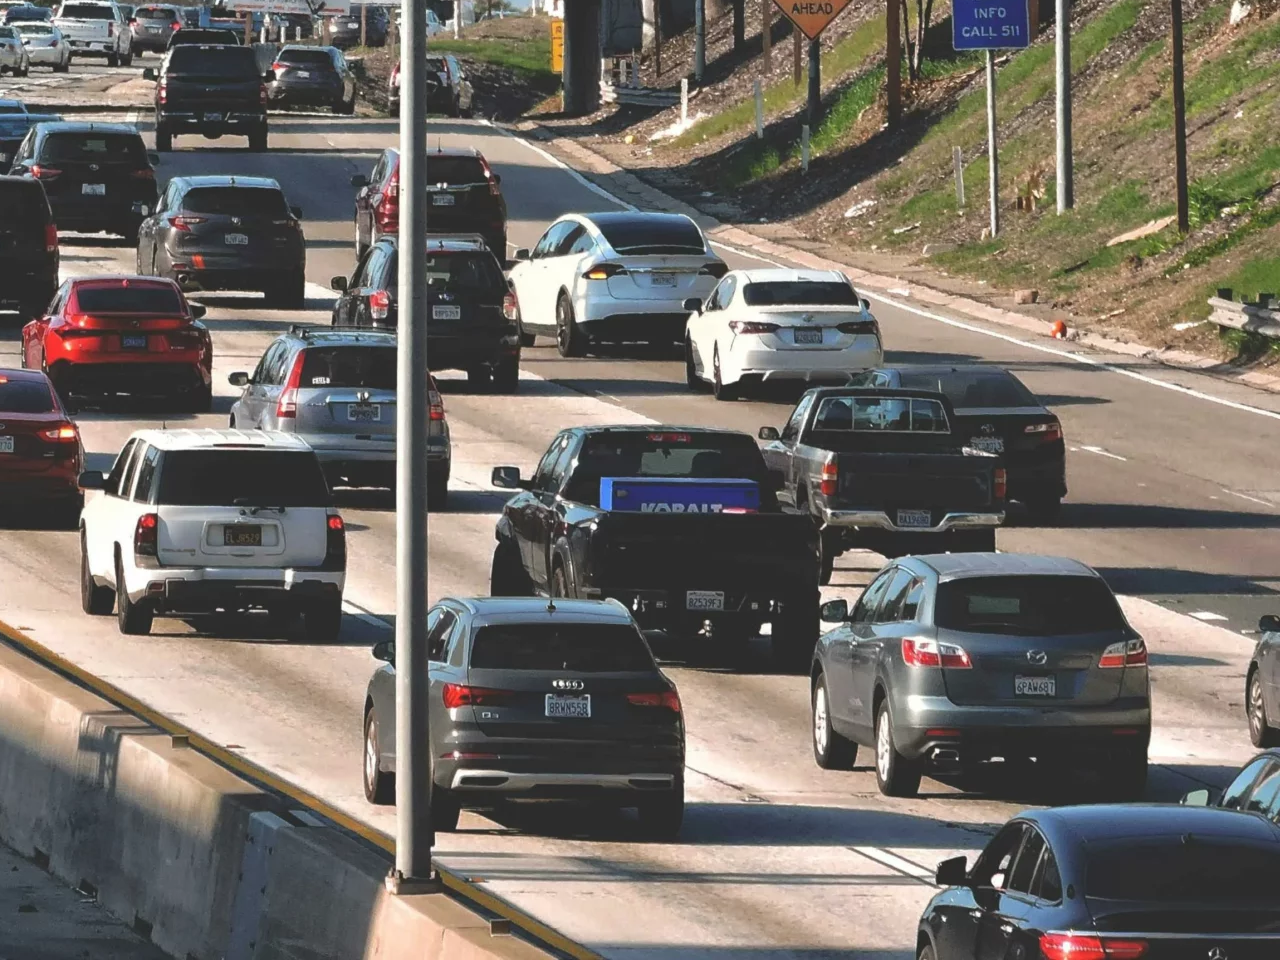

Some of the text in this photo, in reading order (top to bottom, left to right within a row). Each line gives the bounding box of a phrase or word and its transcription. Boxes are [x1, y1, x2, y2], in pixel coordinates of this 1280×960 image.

[791, 3, 833, 16] AHEAD
[973, 8, 1007, 19] INFO
[962, 26, 1020, 38] CALL 511
